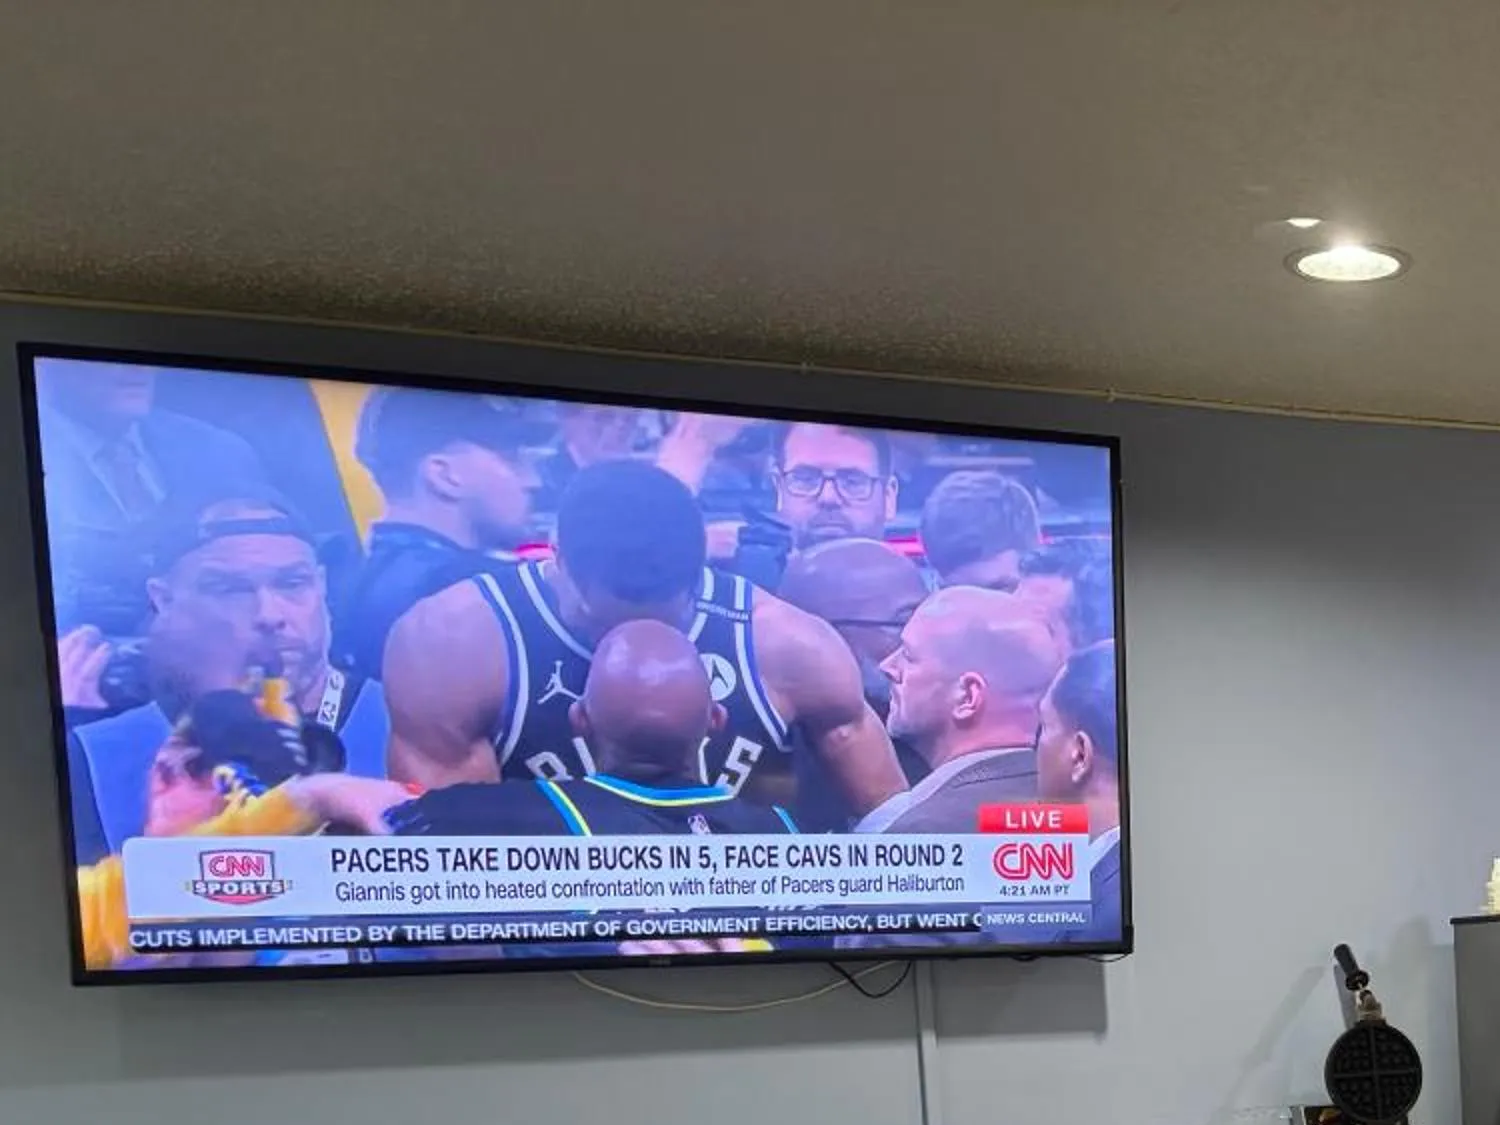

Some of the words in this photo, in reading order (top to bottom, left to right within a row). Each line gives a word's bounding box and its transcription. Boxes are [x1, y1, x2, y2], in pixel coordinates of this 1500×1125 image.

[1005, 810, 1062, 829] LIVE
[208, 855, 265, 877] CNN
[331, 848, 429, 872] PACERS
[437, 848, 499, 871] TAKE
[507, 847, 580, 871] DOWN
[588, 846, 663, 870] BUCKS
[670, 845, 691, 869] IN
[699, 845, 718, 873] 5,
[725, 845, 779, 868] FACE
[786, 844, 841, 867] CAVS
[849, 844, 868, 867] IN
[875, 844, 945, 867] ROUND
[952, 843, 964, 866] 2
[993, 842, 1073, 881] CNN
[194, 880, 283, 895] SPORTS
[335, 881, 405, 902] Giannis
[410, 881, 440, 904] got
[446, 880, 480, 899] into
[485, 879, 546, 899] heated
[551, 877, 665, 898] confrontation
[670, 877, 705, 896] with
[709, 876, 755, 896] father
[761, 876, 776, 894] of
[781, 876, 834, 894] Pacers
[839, 874, 883, 896] guard
[888, 874, 965, 893] Haliburton
[999, 885, 1027, 897] 4:21
[1029, 885, 1051, 896] AM
[1054, 884, 1071, 896] PT
[987, 912, 1025, 925] NEWS
[1027, 911, 1087, 924] CENTRAL
[129, 930, 192, 948] CUTS
[199, 926, 362, 946] IMPLEMENTED
[368, 925, 397, 941] BY
[402, 924, 445, 941] THE
[451, 920, 588, 940] DEPARTMENT
[593, 920, 621, 936] OF
[627, 917, 760, 935] GOVERNMENT
[765, 914, 873, 933] EFFICIENCY,
[878, 914, 912, 929] BUT
[916, 912, 967, 929] WENT
